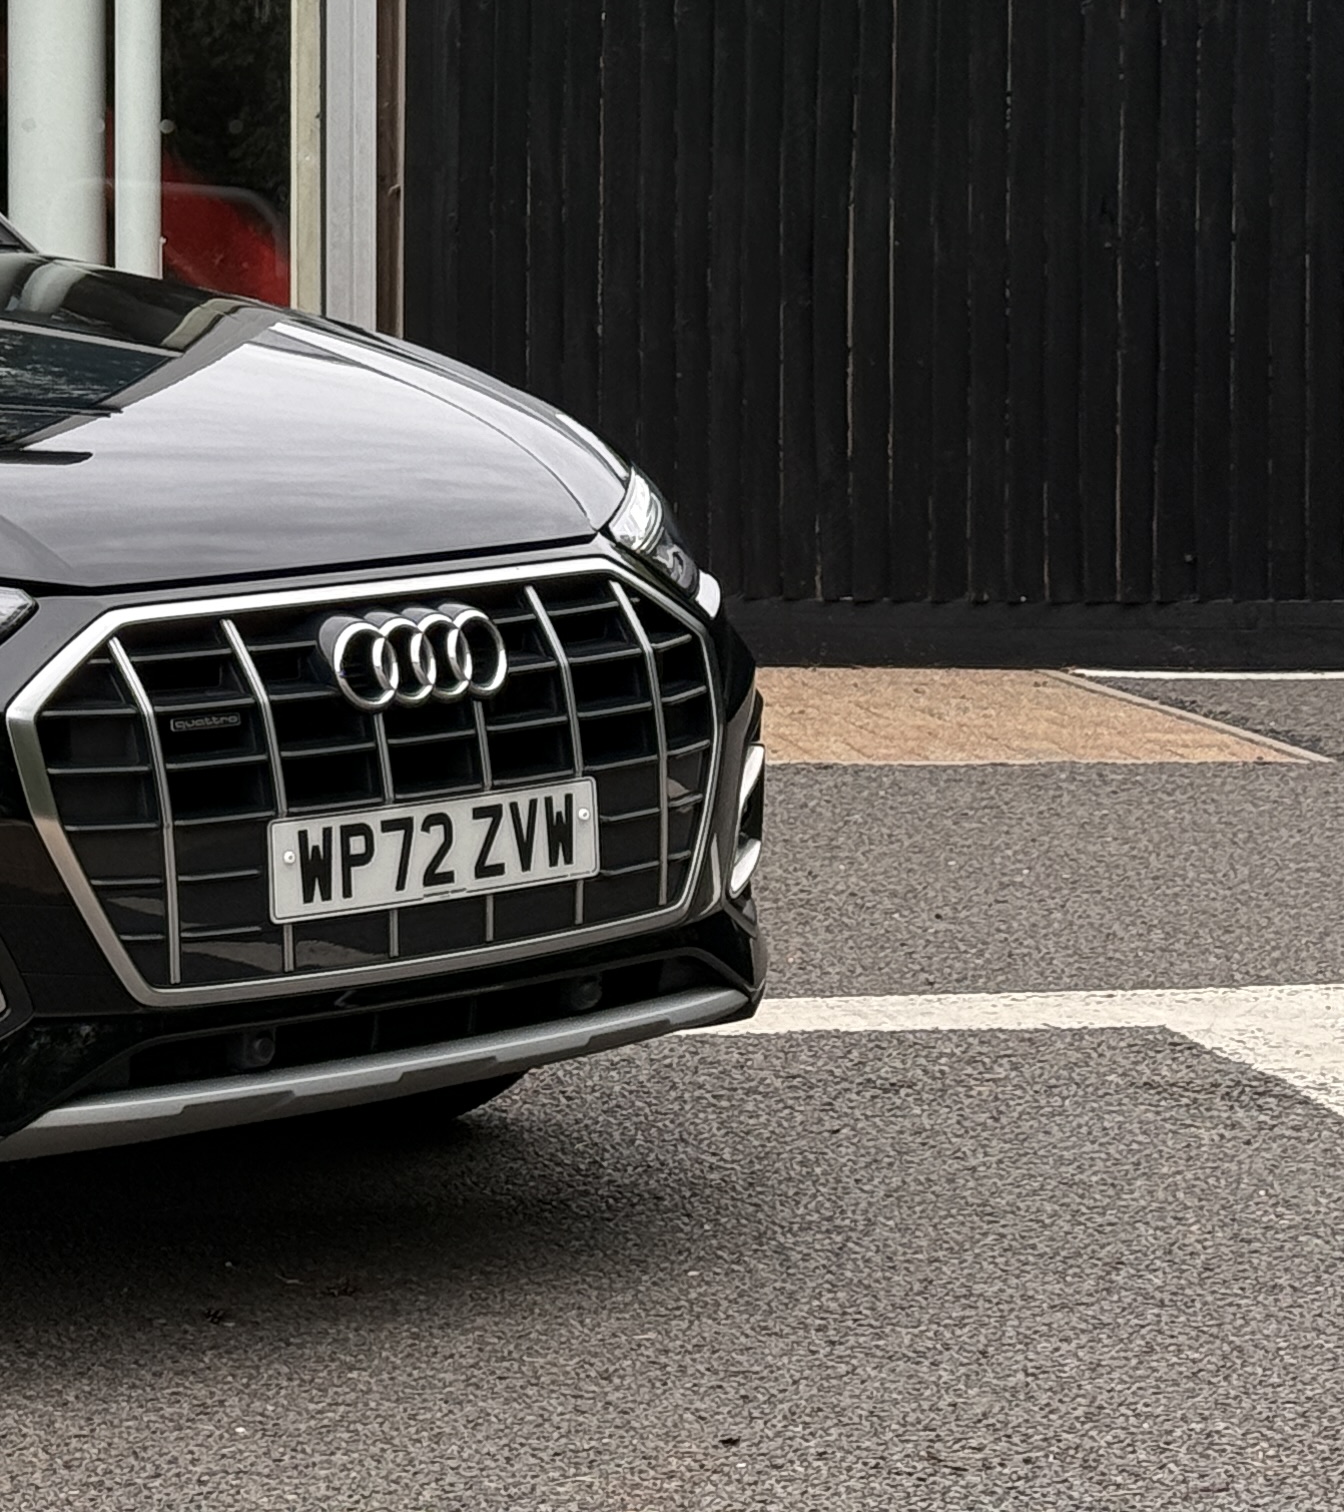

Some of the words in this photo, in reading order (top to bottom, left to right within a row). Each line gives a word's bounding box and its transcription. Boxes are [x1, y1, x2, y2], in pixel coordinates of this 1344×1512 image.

[174, 715, 239, 730] quattro
[297, 811, 455, 905] WP72
[471, 792, 575, 880] ZVW
